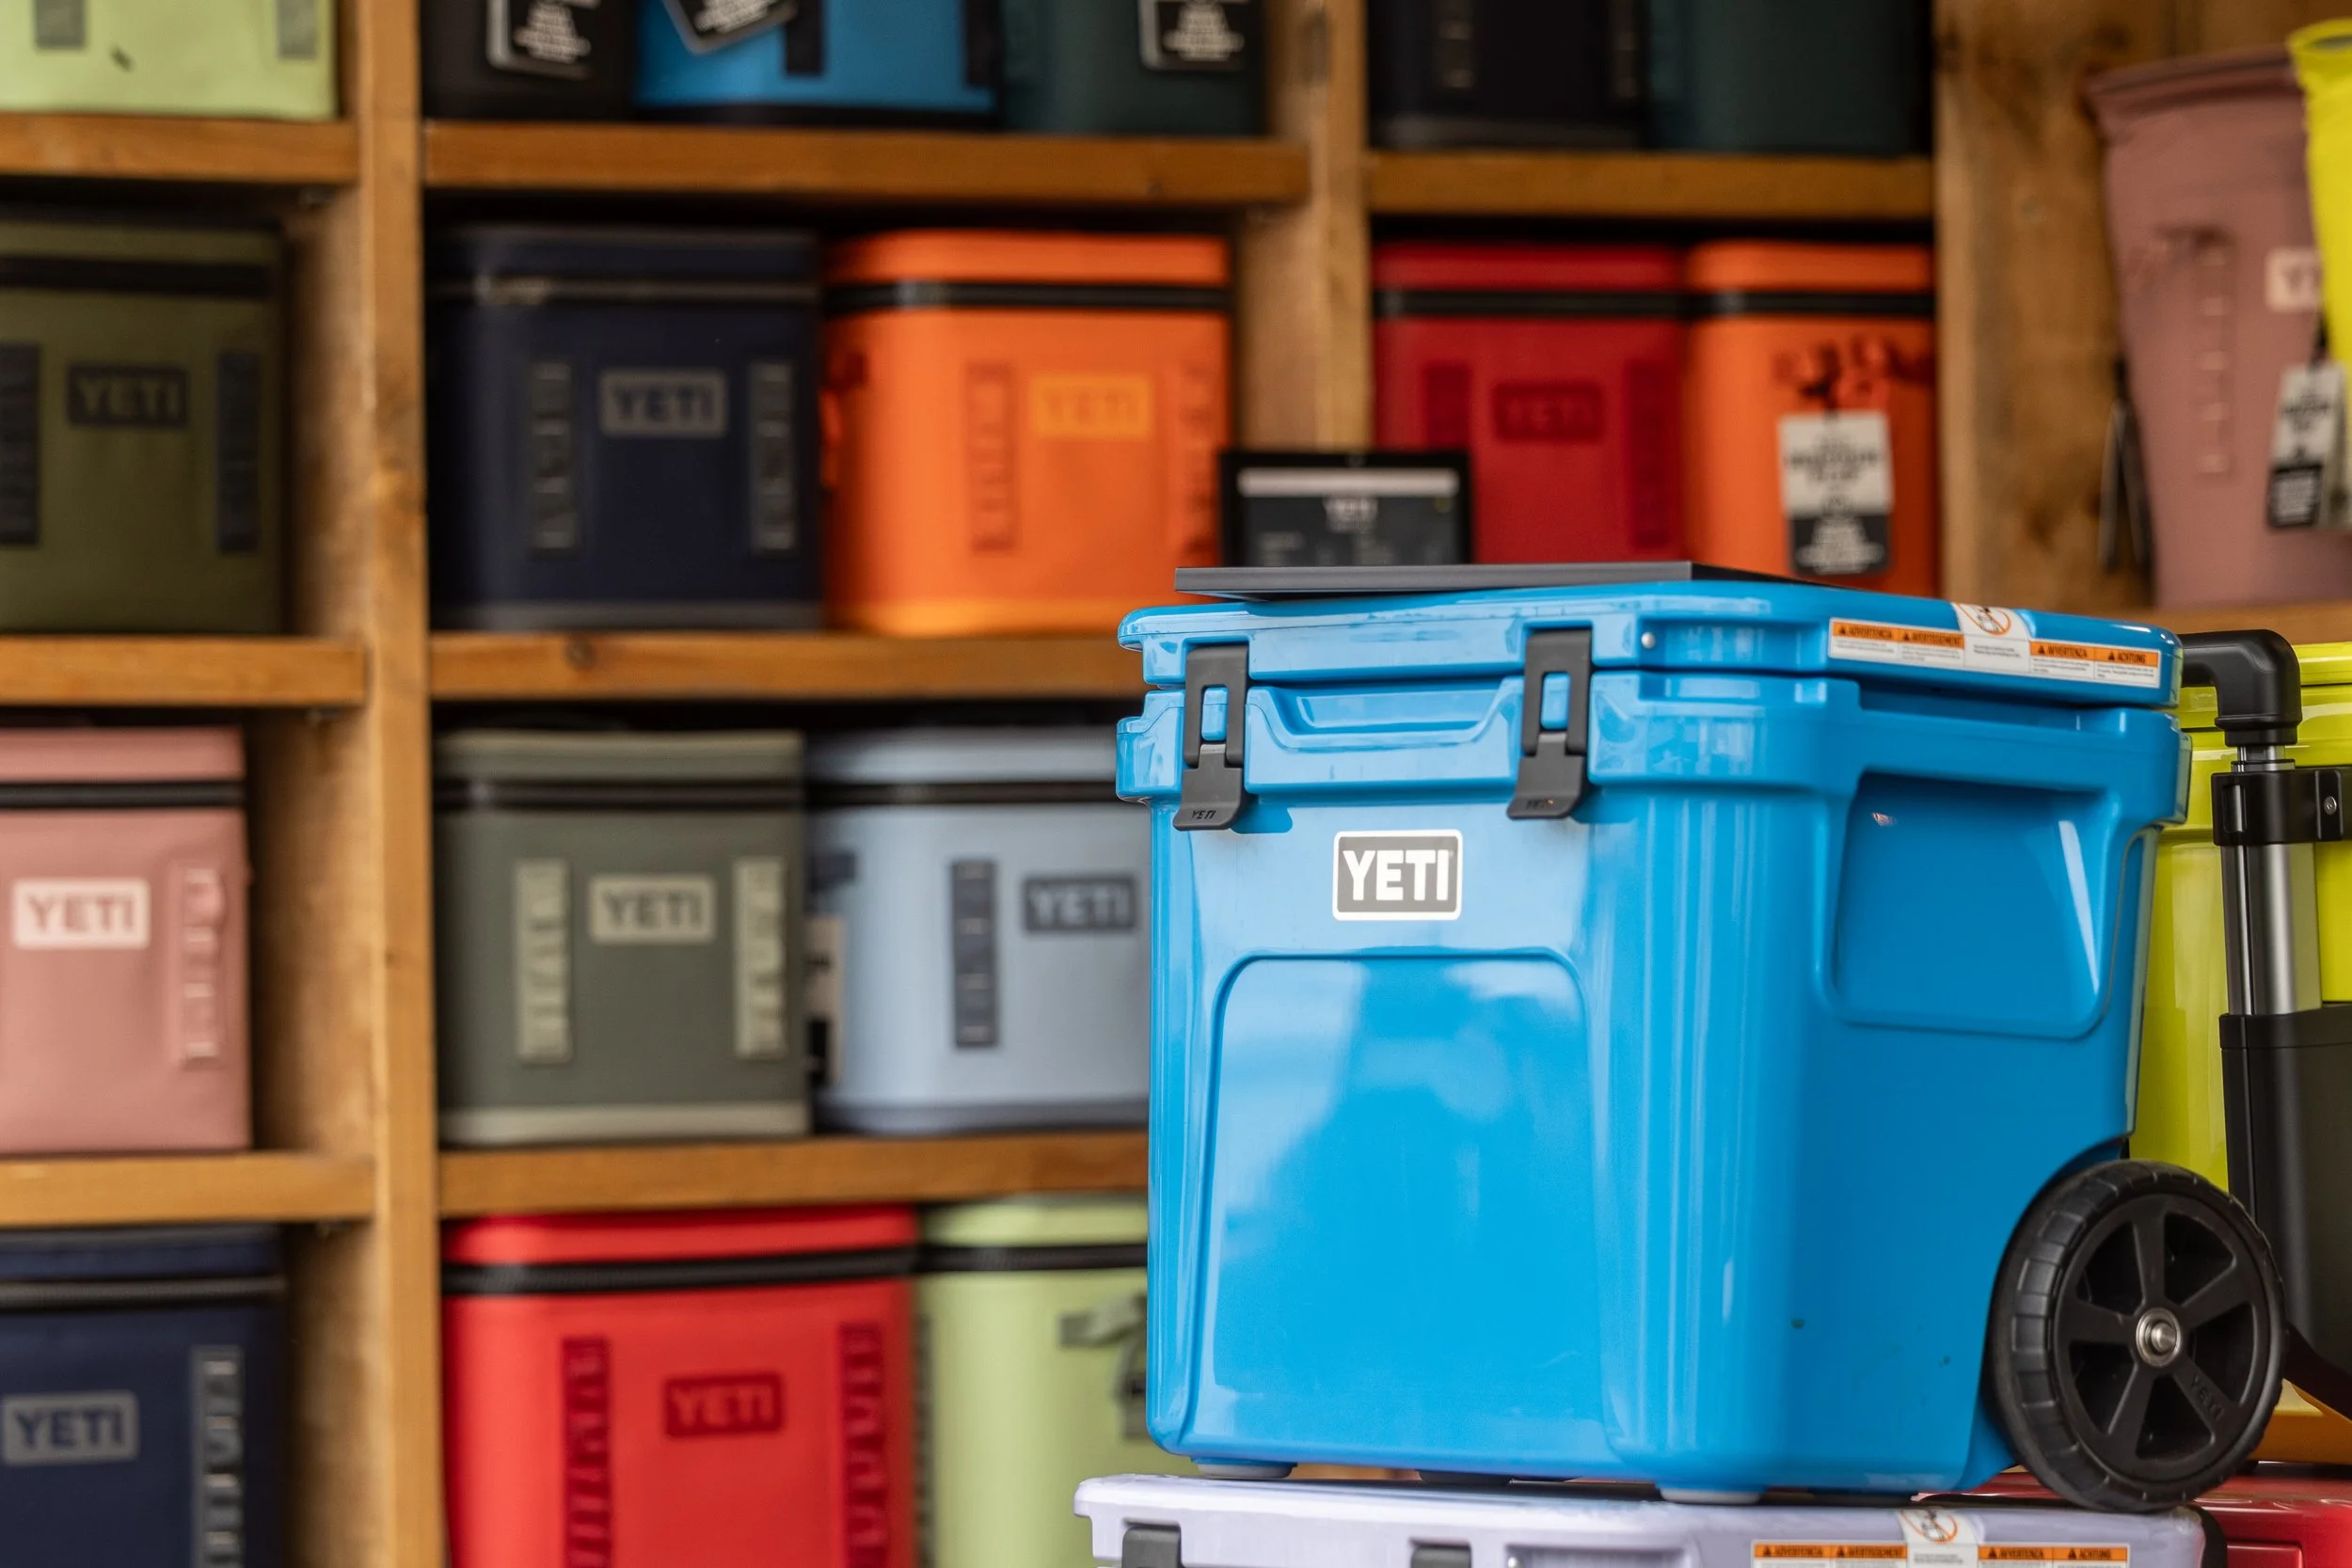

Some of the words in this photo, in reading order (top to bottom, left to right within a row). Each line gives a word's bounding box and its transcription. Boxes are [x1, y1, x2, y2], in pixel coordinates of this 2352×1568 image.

[75, 378, 180, 420] YETI
[612, 387, 713, 422] YETI
[2118, 651, 2146, 664] ACHTUNG
[1190, 810, 1216, 820] YETI
[1343, 849, 1450, 901] YETI
[26, 893, 135, 933] YETI
[601, 889, 703, 929] YETI
[1029, 886, 1130, 926] YETI
[671, 1385, 773, 1428] YETI
[14, 1405, 125, 1449] YETI
